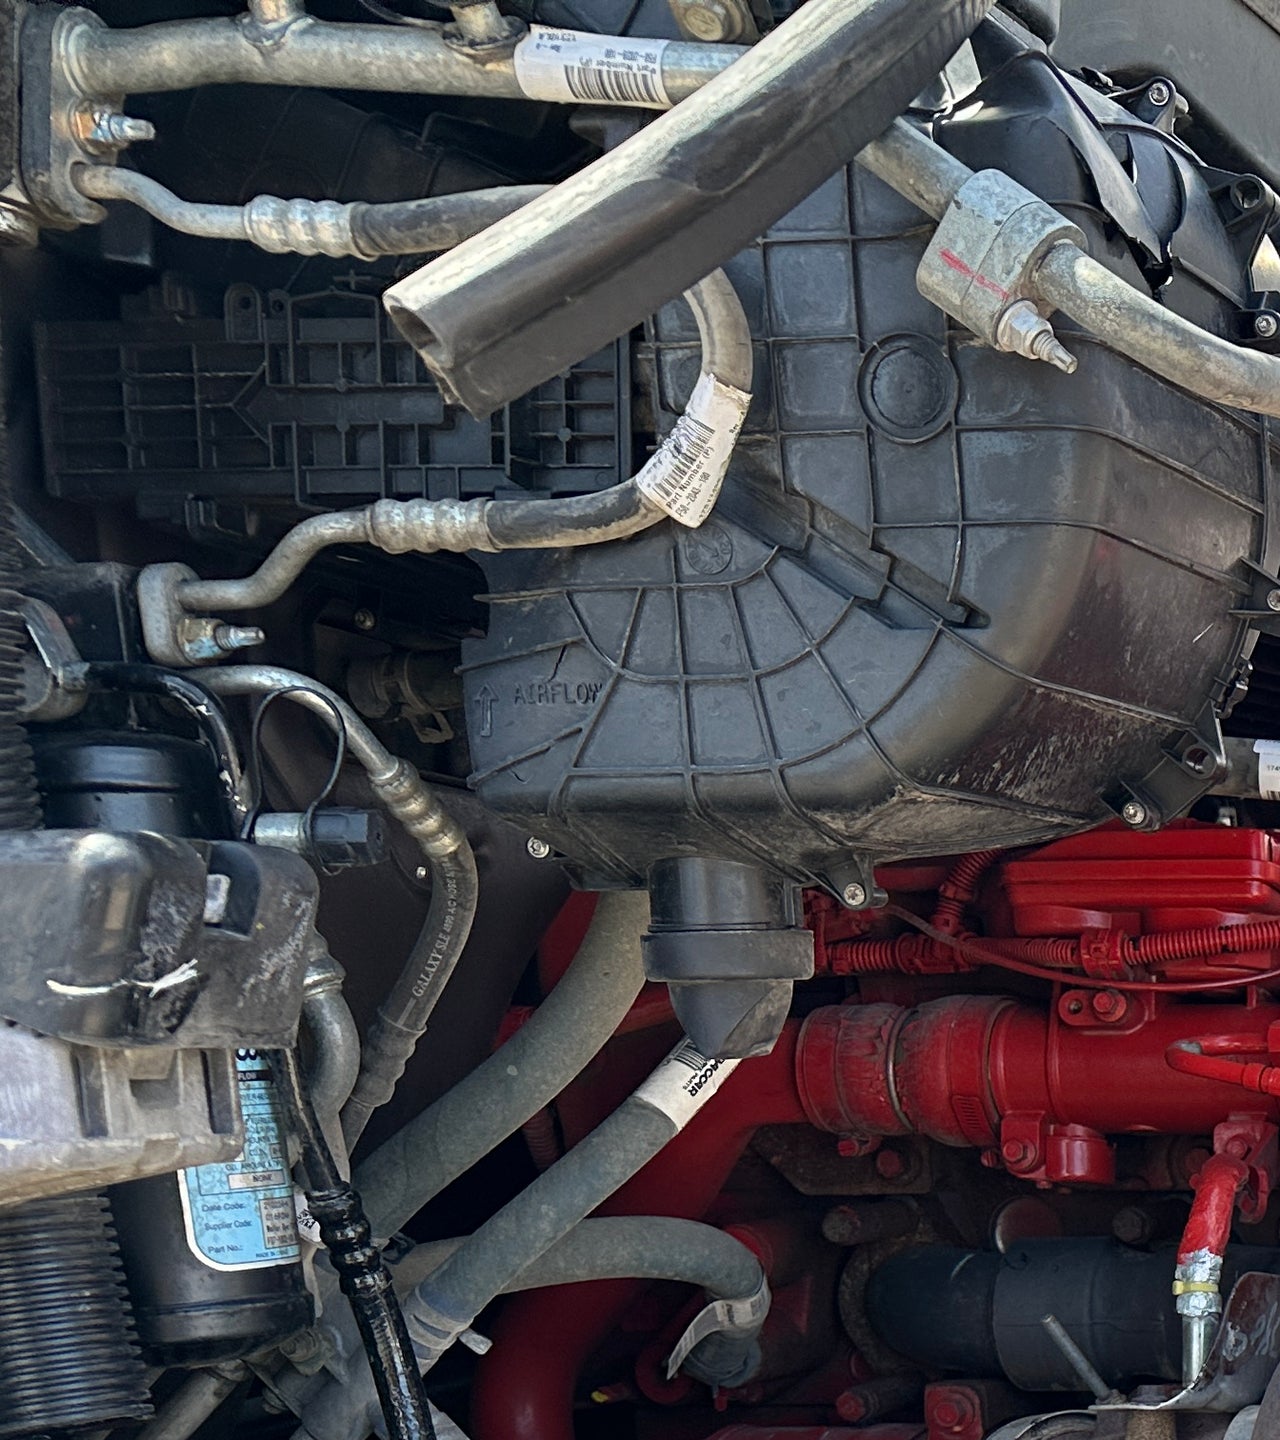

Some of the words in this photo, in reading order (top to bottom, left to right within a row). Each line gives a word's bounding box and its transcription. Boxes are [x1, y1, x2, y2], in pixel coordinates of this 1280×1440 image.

[666, 490, 682, 510] Part
[680, 460, 705, 491] Number
[514, 681, 603, 705] AIRFLOW
[412, 948, 442, 997] GALAXY
[434, 932, 450, 950] SLE
[202, 1204, 222, 1212] Date
